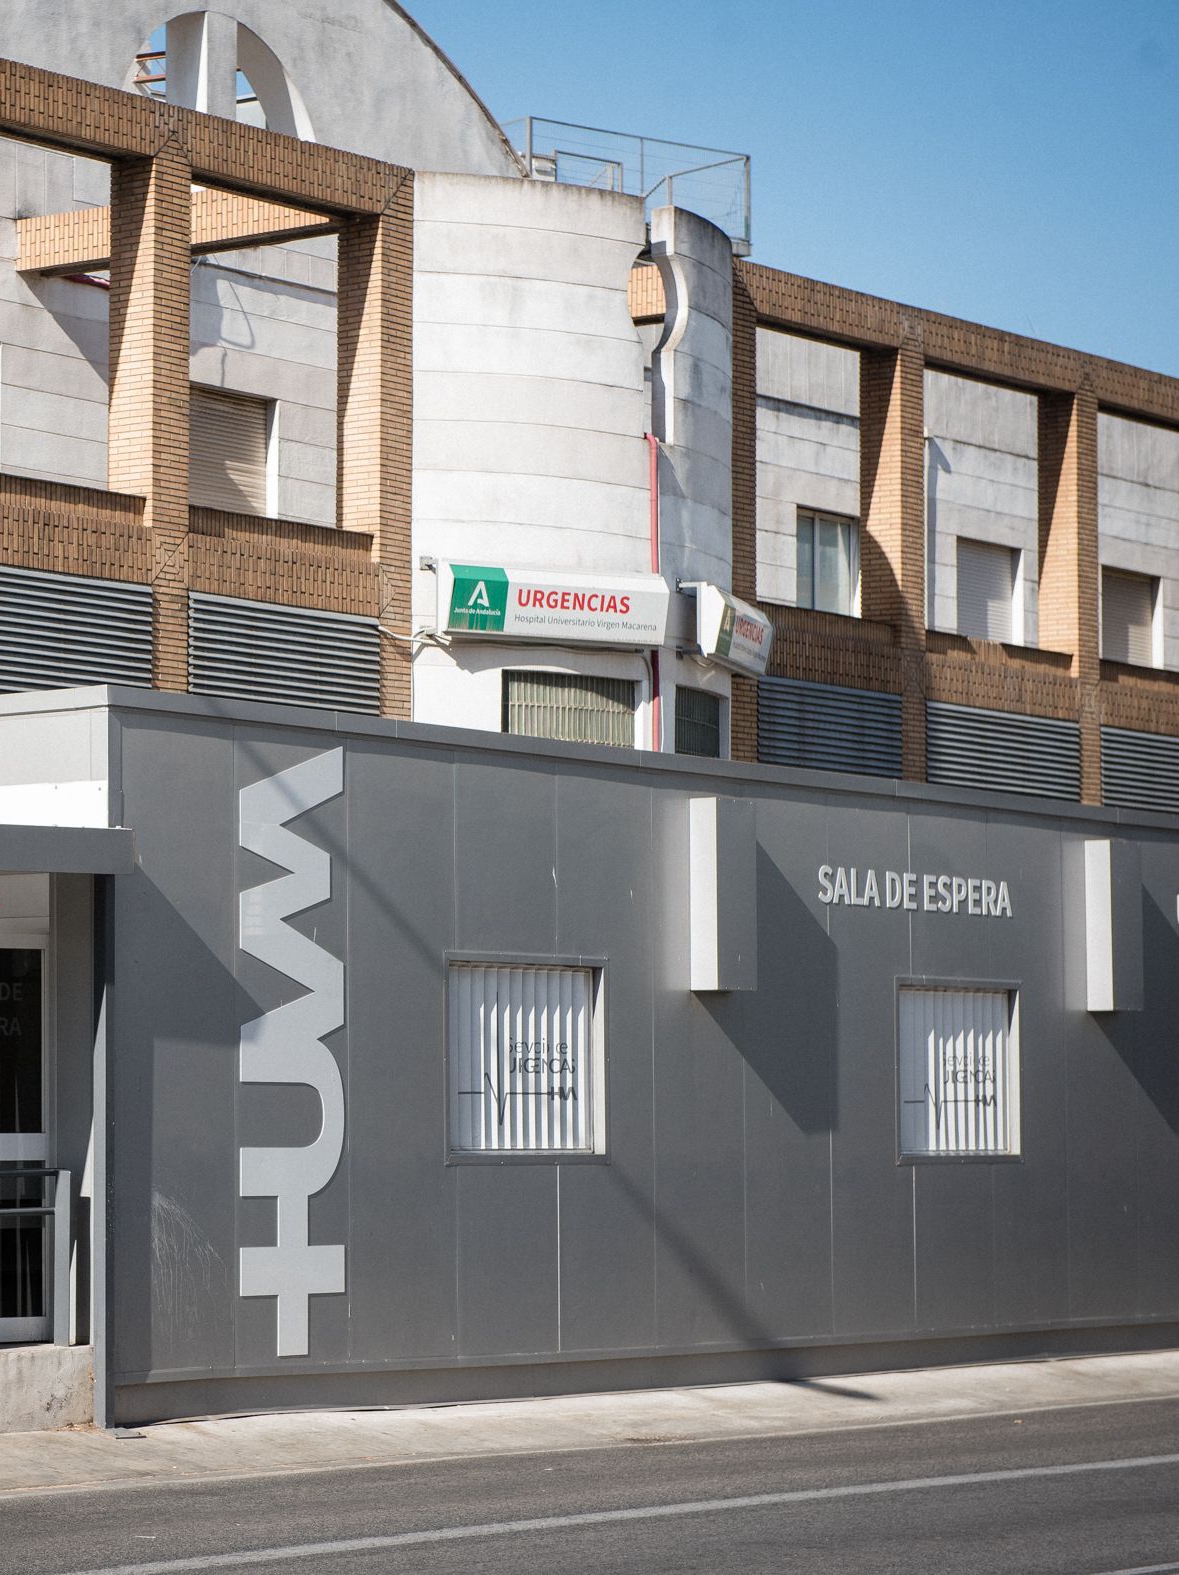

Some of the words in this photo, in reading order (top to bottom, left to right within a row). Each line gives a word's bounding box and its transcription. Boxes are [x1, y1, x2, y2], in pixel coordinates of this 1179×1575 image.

[454, 606, 468, 614] Junta
[476, 607, 501, 616] Andalucía
[517, 588, 630, 615] URGENCIAS
[514, 614, 546, 625] Hospital
[547, 615, 595, 627] Universitario
[596, 619, 620, 630] Virgen
[621, 621, 657, 632] Macarena
[735, 615, 764, 646] URGENCIAS
[817, 864, 881, 908] SALA
[885, 870, 918, 912] DE
[923, 874, 1014, 918] ESPERA
